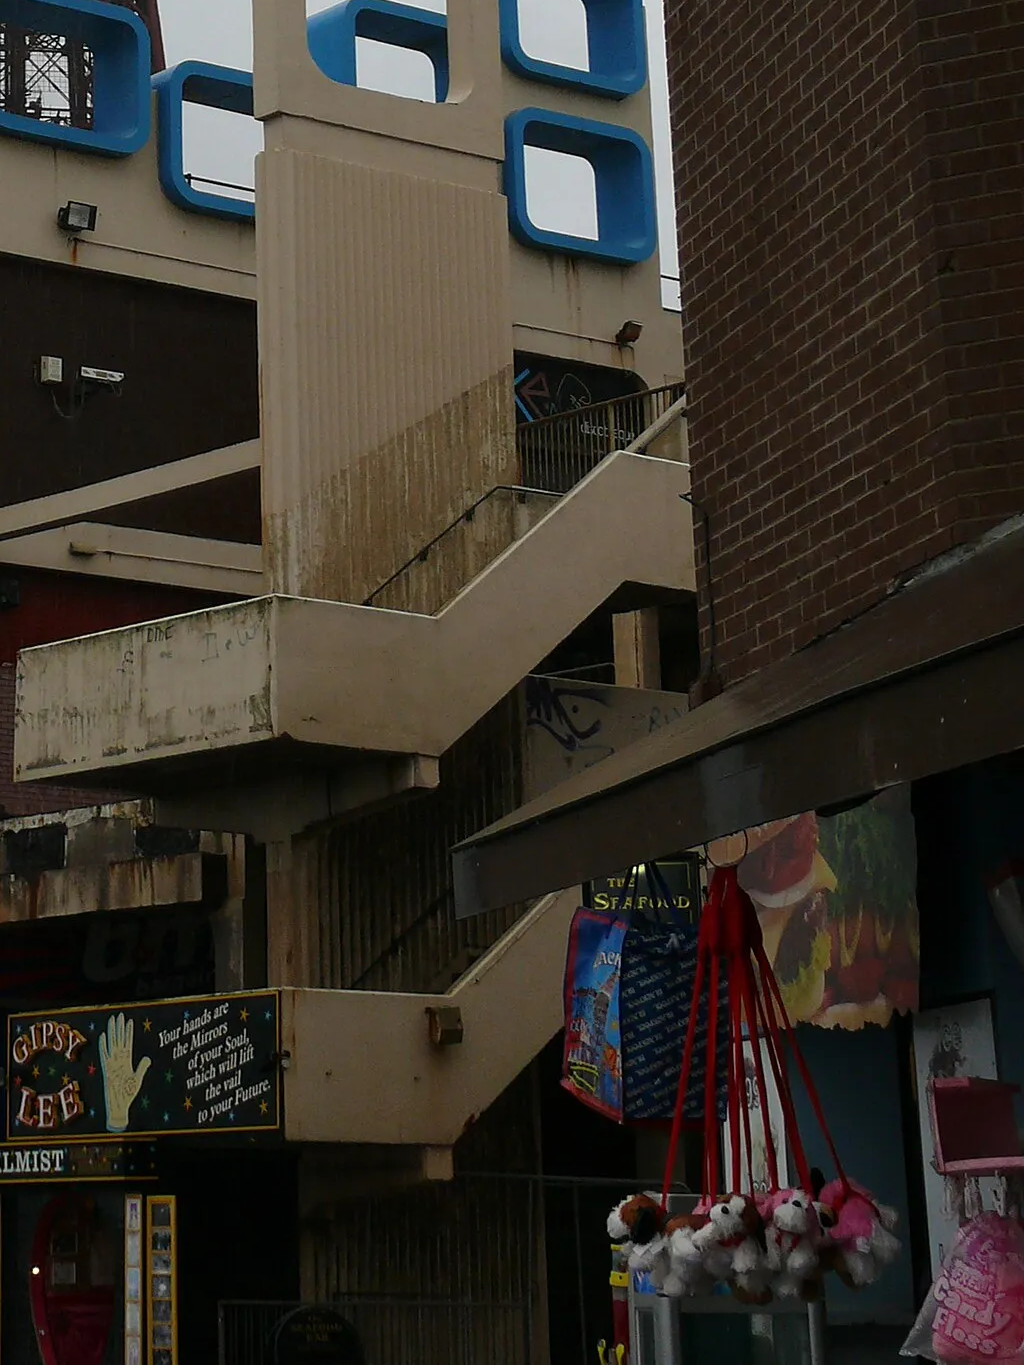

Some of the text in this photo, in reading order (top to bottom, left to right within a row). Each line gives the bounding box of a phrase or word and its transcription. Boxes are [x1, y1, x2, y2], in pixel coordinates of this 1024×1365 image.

[13, 1020, 85, 1064] GIPSY
[158, 1001, 230, 1048] Your hands are
[172, 1021, 228, 1060] the Mirrors
[186, 1043, 255, 1090] which will lift
[187, 1027, 250, 1071] of your Soul,
[16, 1082, 81, 1130] LEE
[197, 1078, 271, 1124] to your Future.
[205, 1068, 242, 1101] the vail
[933, 1275, 1012, 1337] Candy
[931, 1306, 998, 1355] Floss
